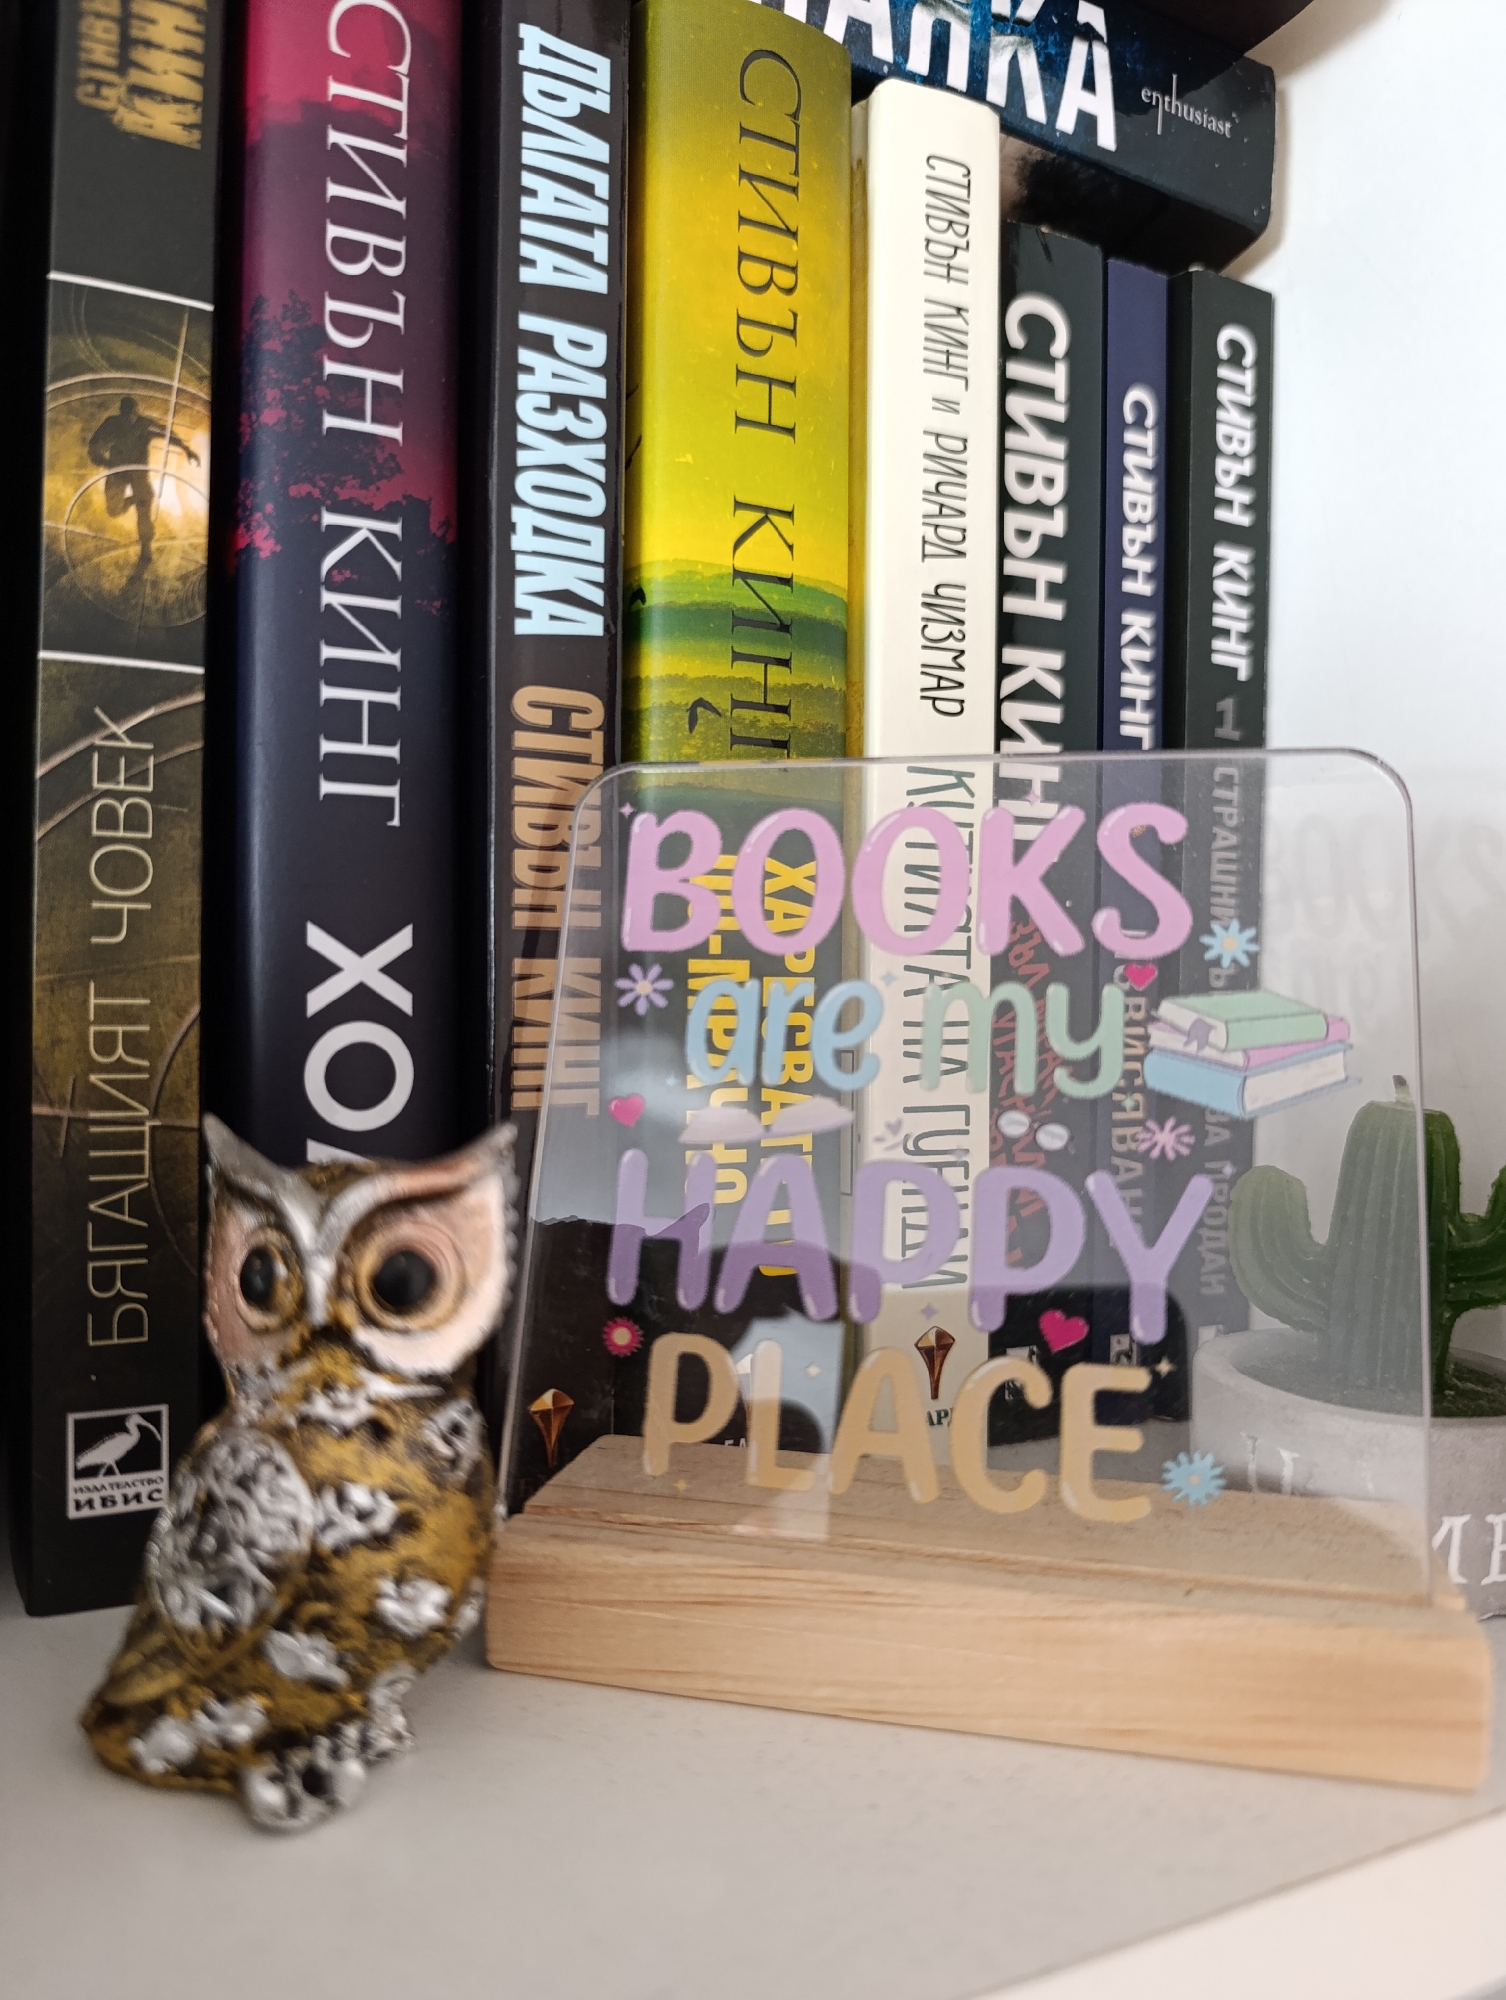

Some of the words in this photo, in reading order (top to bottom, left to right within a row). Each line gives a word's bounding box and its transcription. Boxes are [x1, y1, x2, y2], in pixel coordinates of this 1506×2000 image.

[112, 0, 207, 150] КИН
[519, 24, 612, 294] ДЪЛГАТА
[1141, 73, 1232, 139] enthusiast
[324, 0, 413, 446] СТИВЪН
[733, 49, 802, 444] СТИВЪН
[924, 154, 972, 287] СТИВЪН
[922, 298, 969, 391] КИНГ
[1214, 324, 1258, 527] СТИВЪН
[514, 311, 608, 637] РАЗХОДКА
[920, 429, 969, 564] РИЧАРД
[1002, 298, 1071, 621] СТИВЪН
[1121, 385, 1158, 597] СТИВЪН
[317, 506, 403, 827] КИНГ
[919, 583, 967, 718] ЧИЗМАР
[1119, 610, 1155, 750] КИНГ
[1210, 543, 1254, 681] КИНГ
[91, 706, 154, 946] ЧОВЕК
[511, 685, 605, 930] СТИВЪН
[621, 806, 1194, 957] BOOKS
[304, 919, 414, 1165] ХО
[511, 957, 601, 1116] КИНГ
[686, 977, 886, 1092] are
[922, 980, 1125, 1097] my
[86, 980, 152, 1345] БЯГАЩИЯТ
[607, 1148, 1214, 1345] HAPPY
[74, 1488, 164, 1513] ИБИС
[641, 1331, 1153, 1523] PLACE
